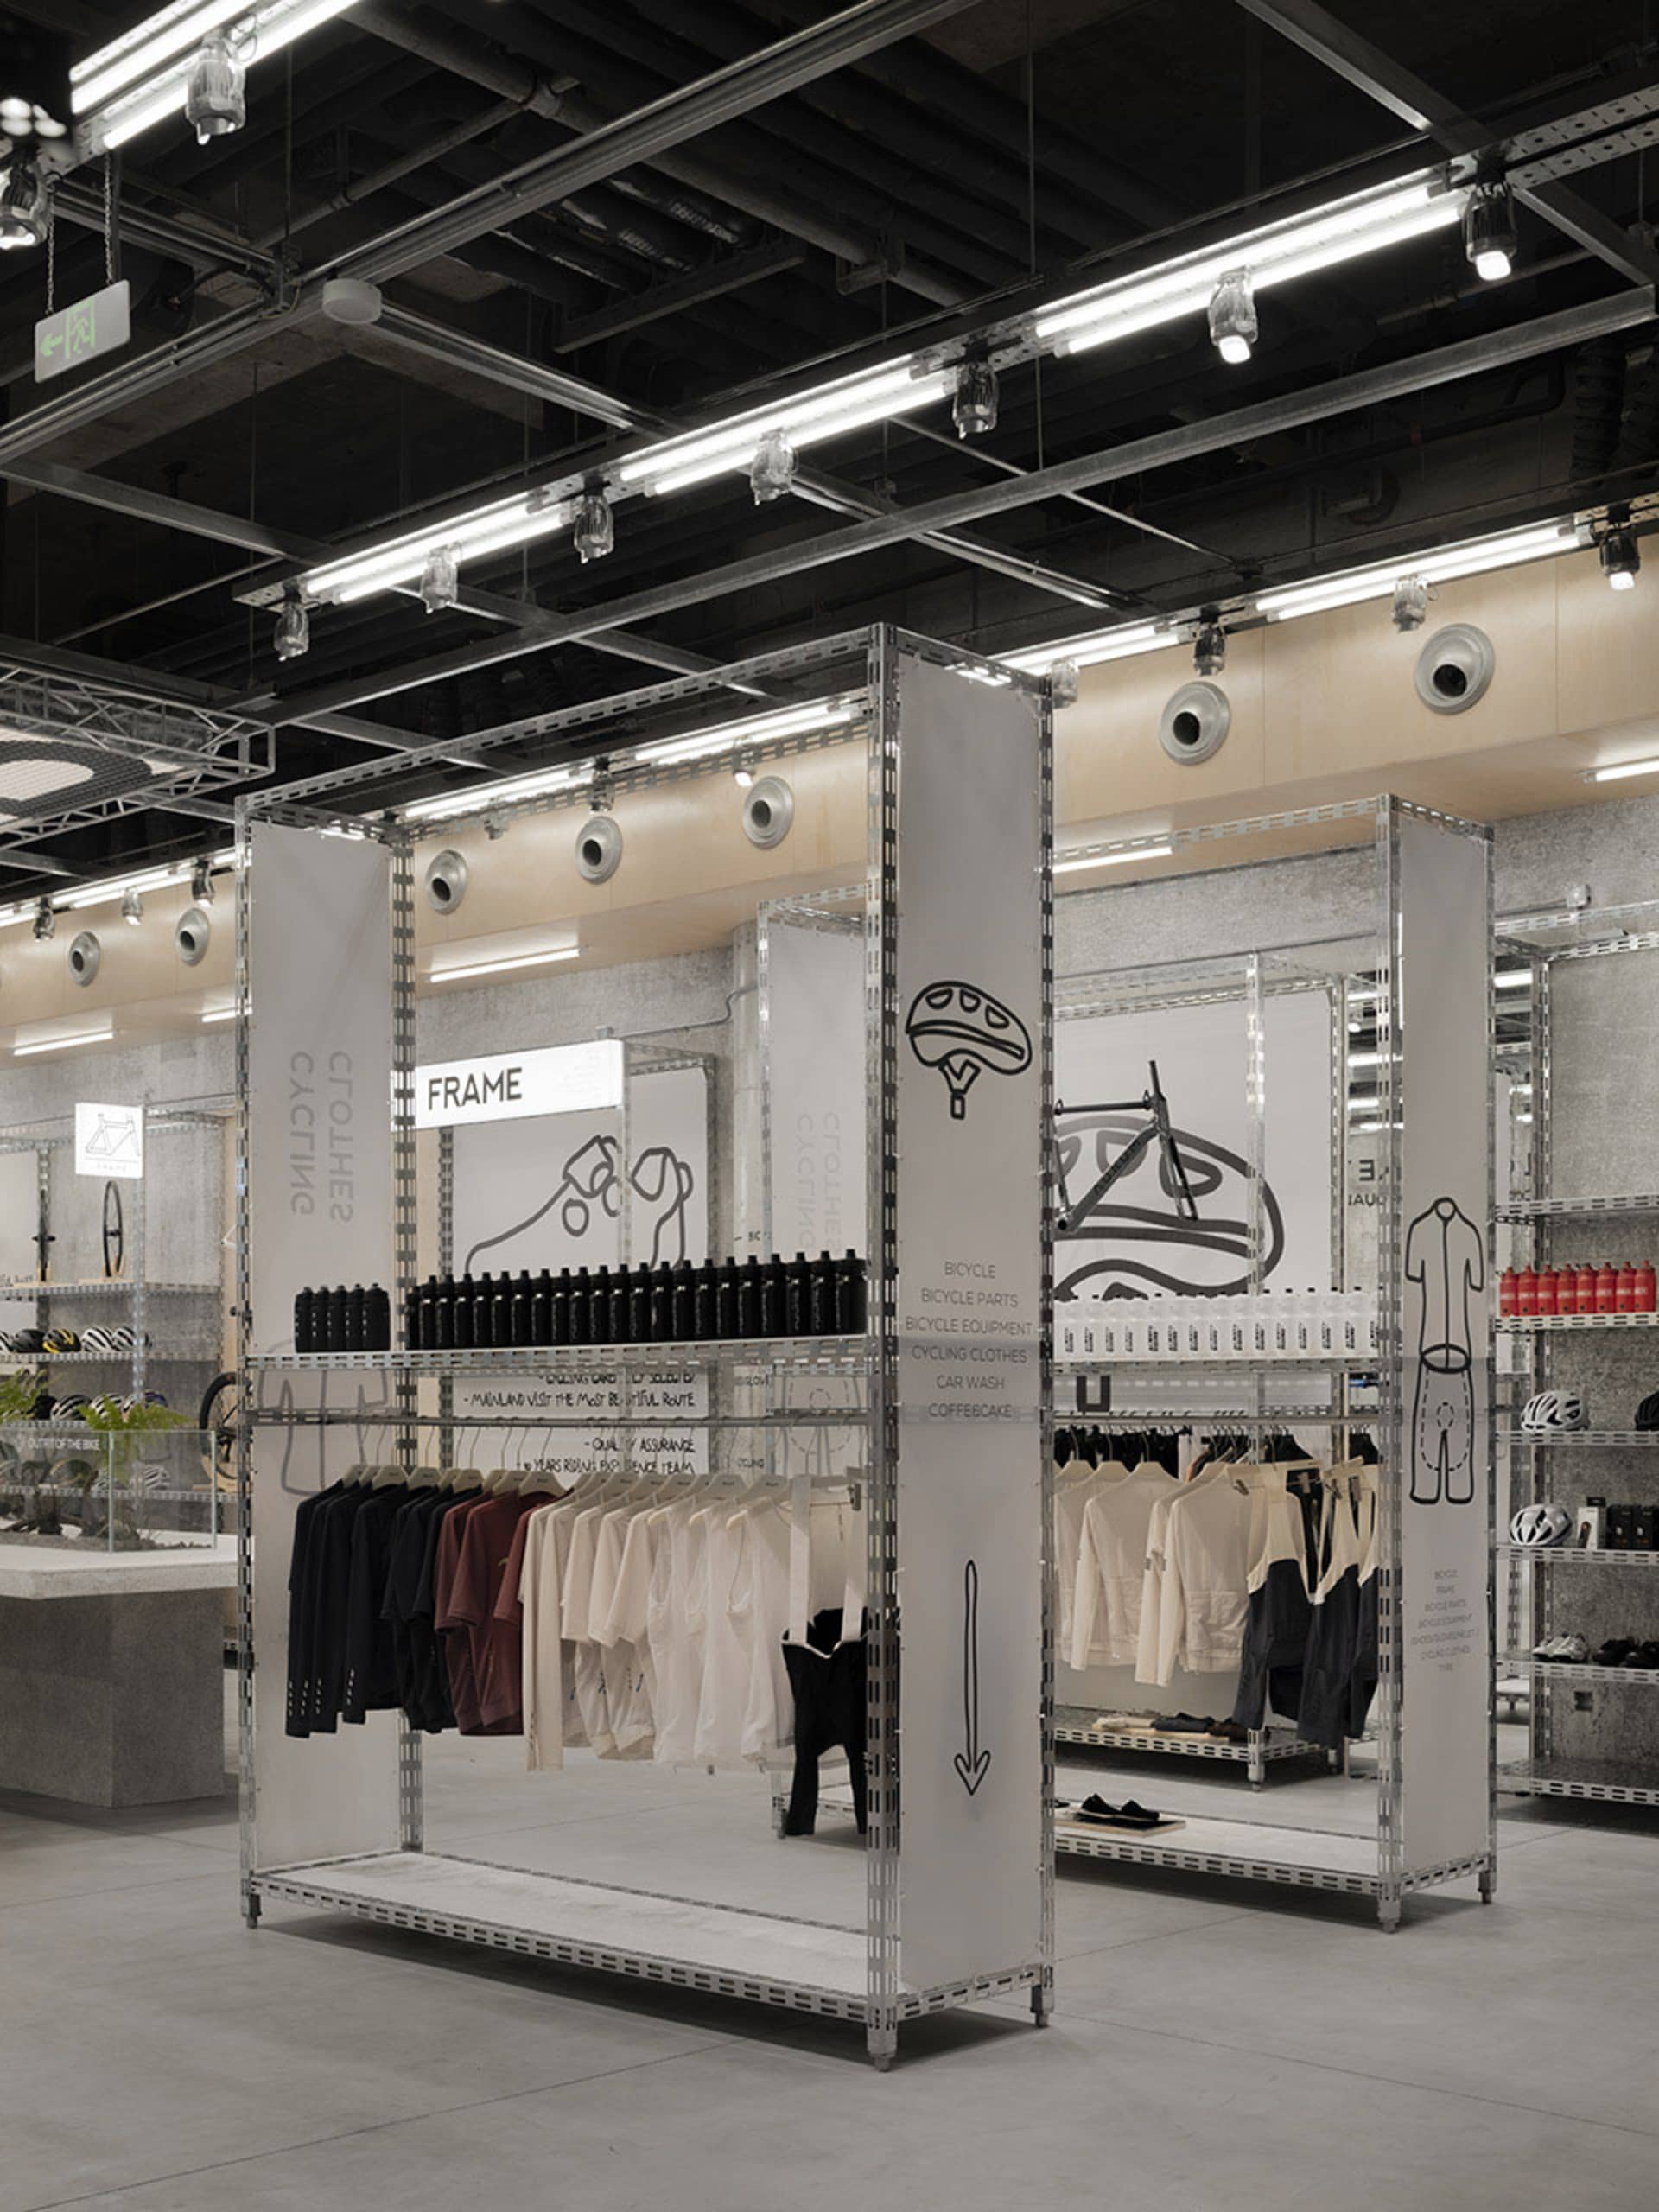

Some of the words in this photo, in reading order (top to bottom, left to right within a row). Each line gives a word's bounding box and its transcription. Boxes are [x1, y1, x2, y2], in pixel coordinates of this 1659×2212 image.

[429, 1067, 523, 1110] FRAME
[944, 1262, 995, 1279] BICYCLE
[921, 1287, 974, 1306] BICYCLE
[977, 1292, 1019, 1308] PARTS
[906, 1316, 959, 1332] BICYCLE
[962, 1319, 1033, 1336] EQUIPMENT
[912, 1344, 968, 1362] CYCLING
[969, 1348, 1027, 1363] CLOTHES
[936, 1375, 963, 1389] CAR
[966, 1376, 1005, 1390] WASH
[556, 1393, 573, 1407] THE
[640, 1438, 696, 1452] ASSURANCE
[661, 1460, 695, 1474] TEAM
